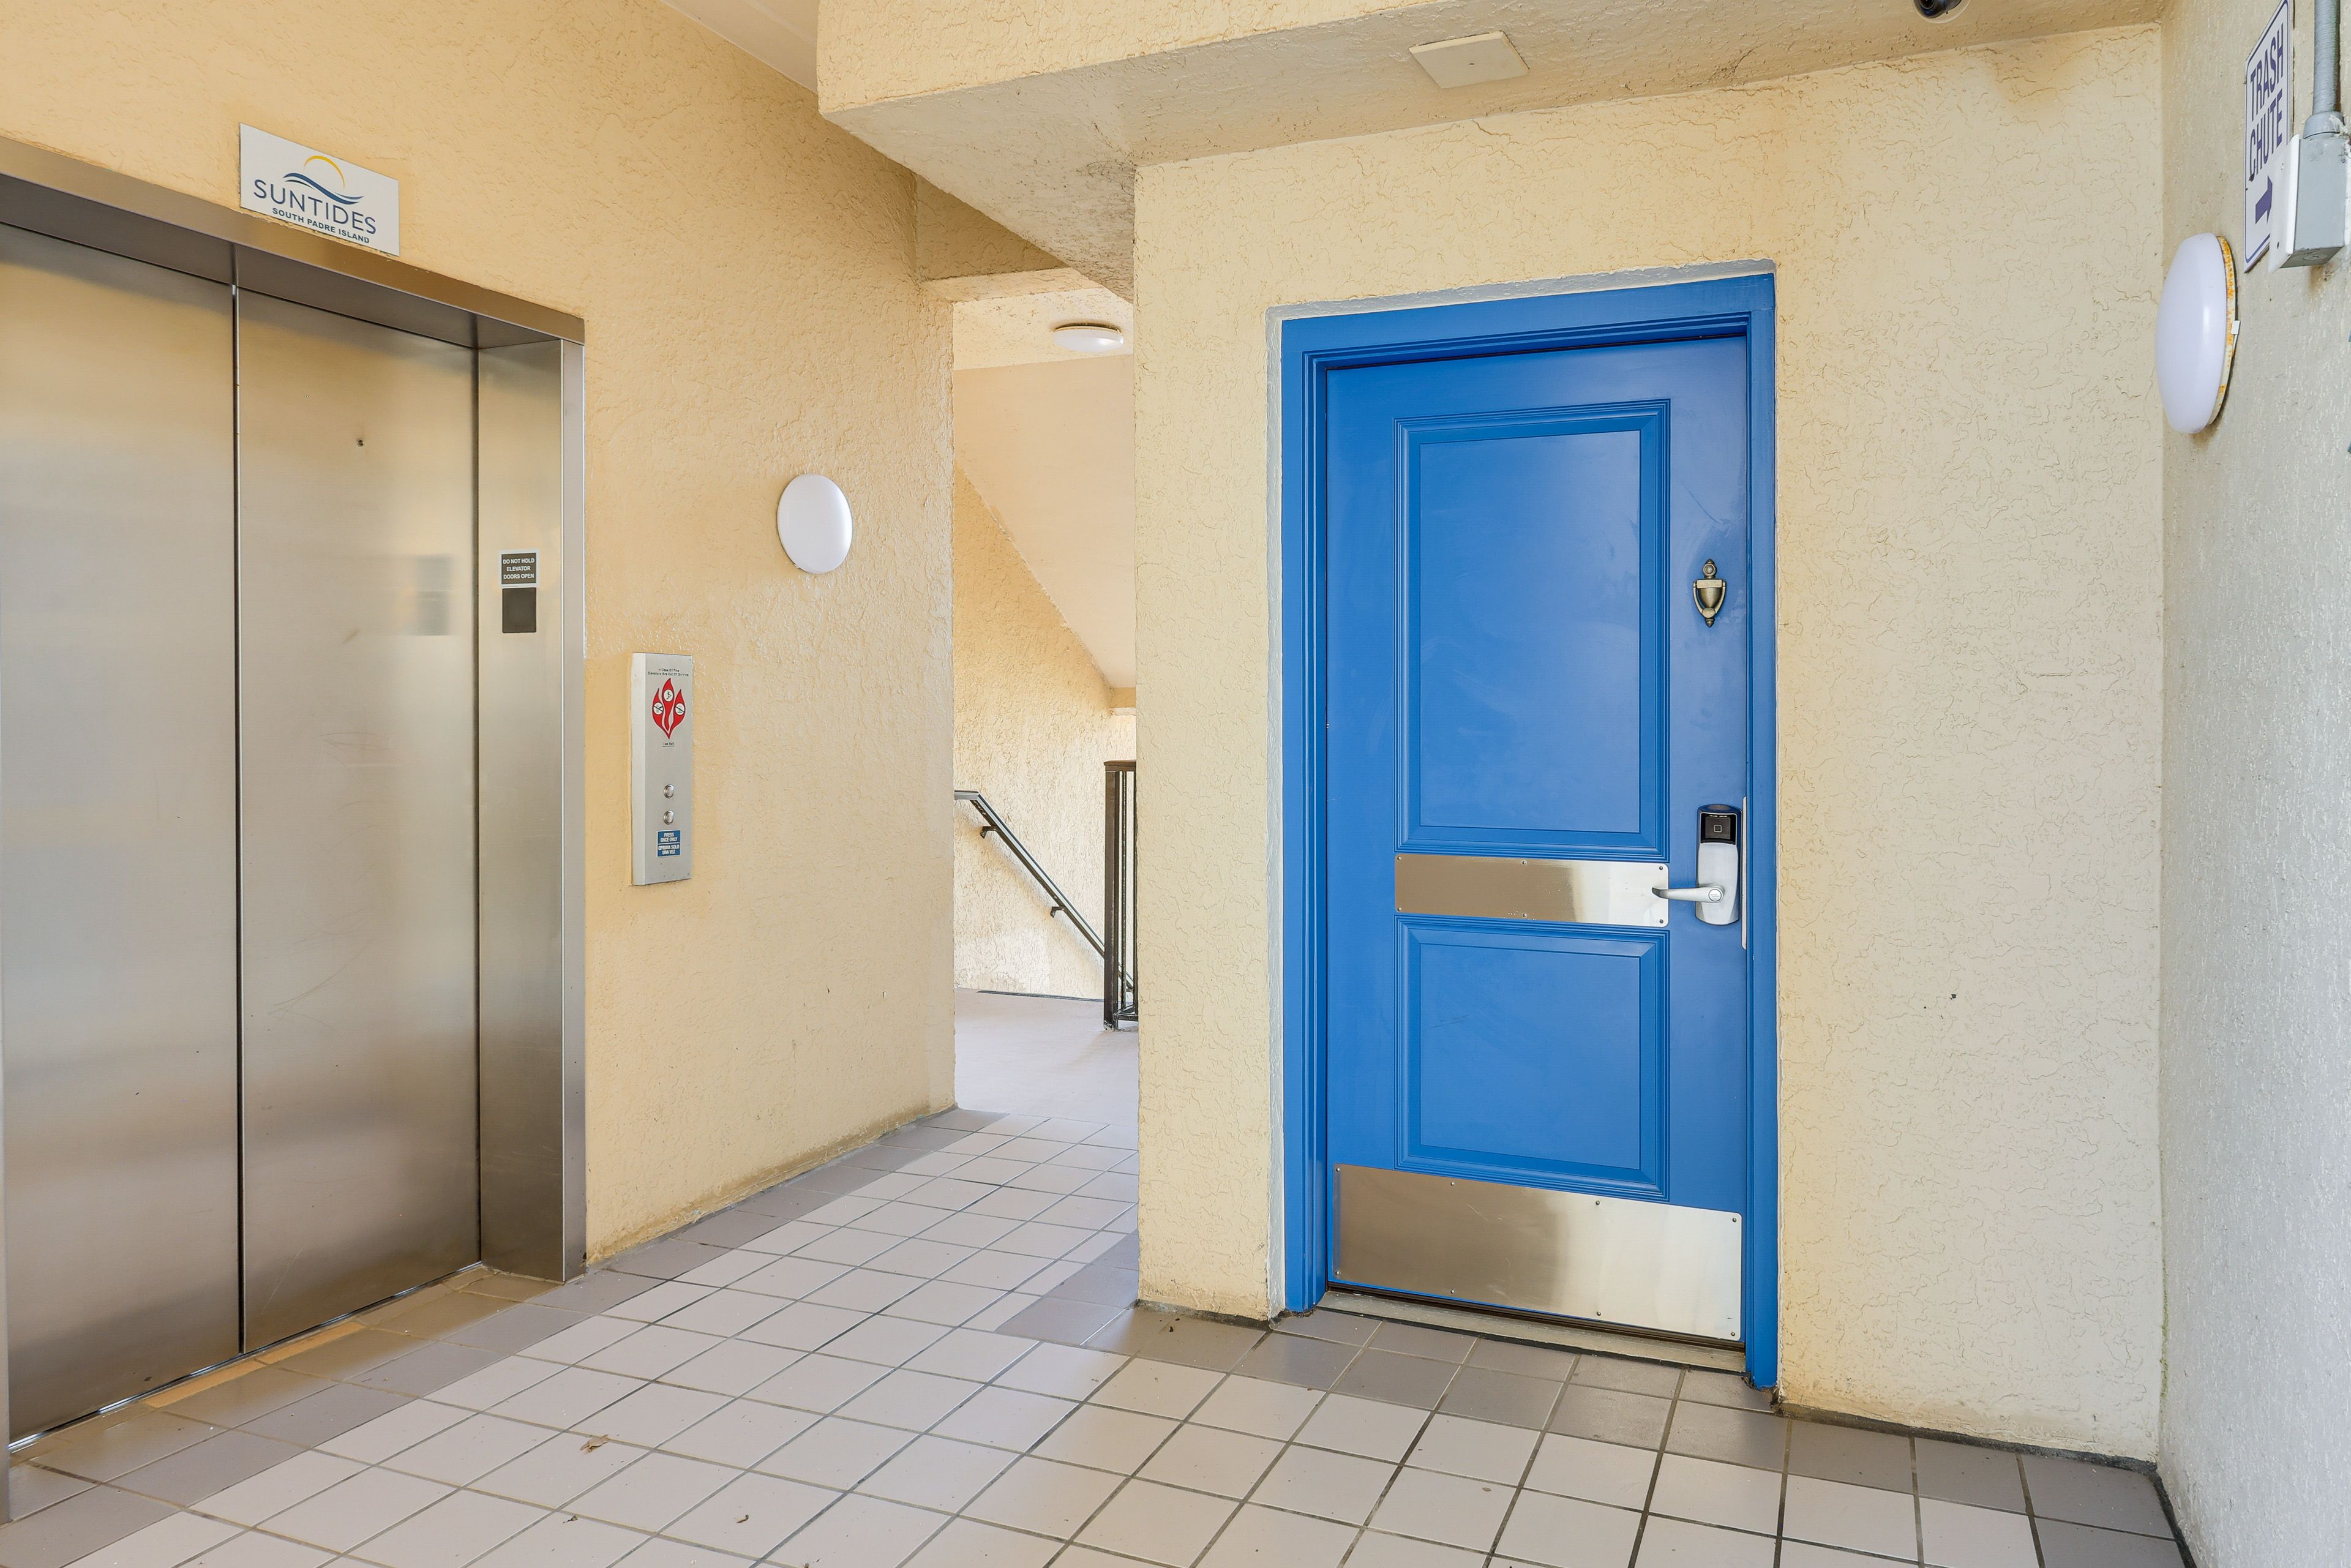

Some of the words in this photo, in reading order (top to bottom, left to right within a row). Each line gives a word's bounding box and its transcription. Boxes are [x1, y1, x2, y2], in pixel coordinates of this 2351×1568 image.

[2250, 22, 2284, 122] TRASH
[2249, 88, 2283, 180] CHUTE
[253, 179, 377, 234] SUNTIDES
[272, 207, 304, 223] SOUTH
[307, 218, 336, 233] PADRE
[338, 228, 370, 244] ISLAND
